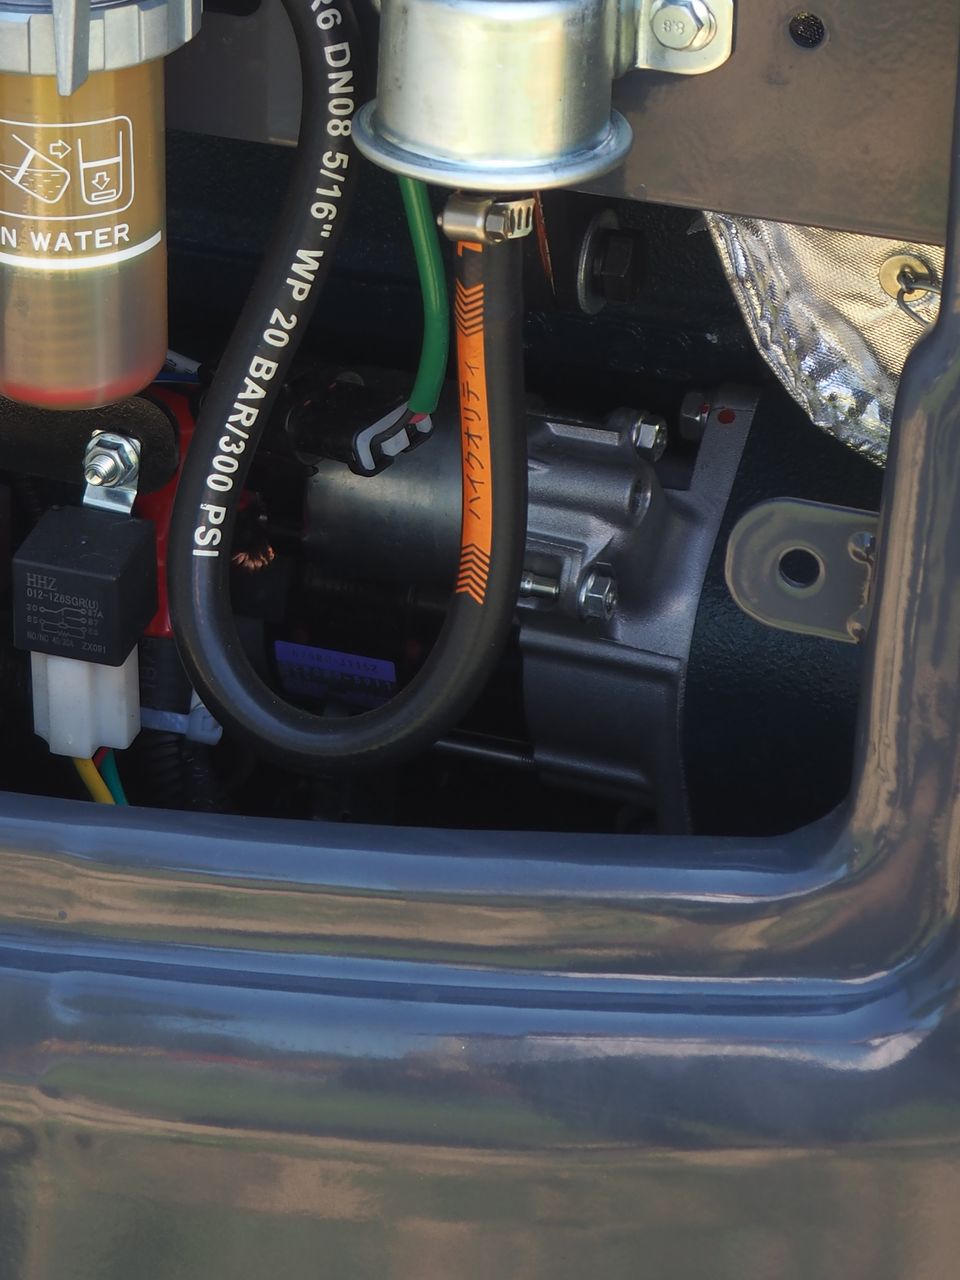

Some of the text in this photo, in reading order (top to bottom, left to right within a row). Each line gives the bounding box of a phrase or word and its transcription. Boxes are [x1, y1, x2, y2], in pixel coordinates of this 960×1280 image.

[324, 42, 355, 138] DN08
[310, 150, 350, 238] 5/16"
[30, 223, 130, 252] WATER
[286, 248, 325, 302] WP
[263, 307, 298, 348] 20
[205, 355, 279, 493] BAR/300
[463, 359, 483, 521] ハイクオリティ
[192, 502, 227, 557] PSI
[25, 572, 57, 592] HHZ
